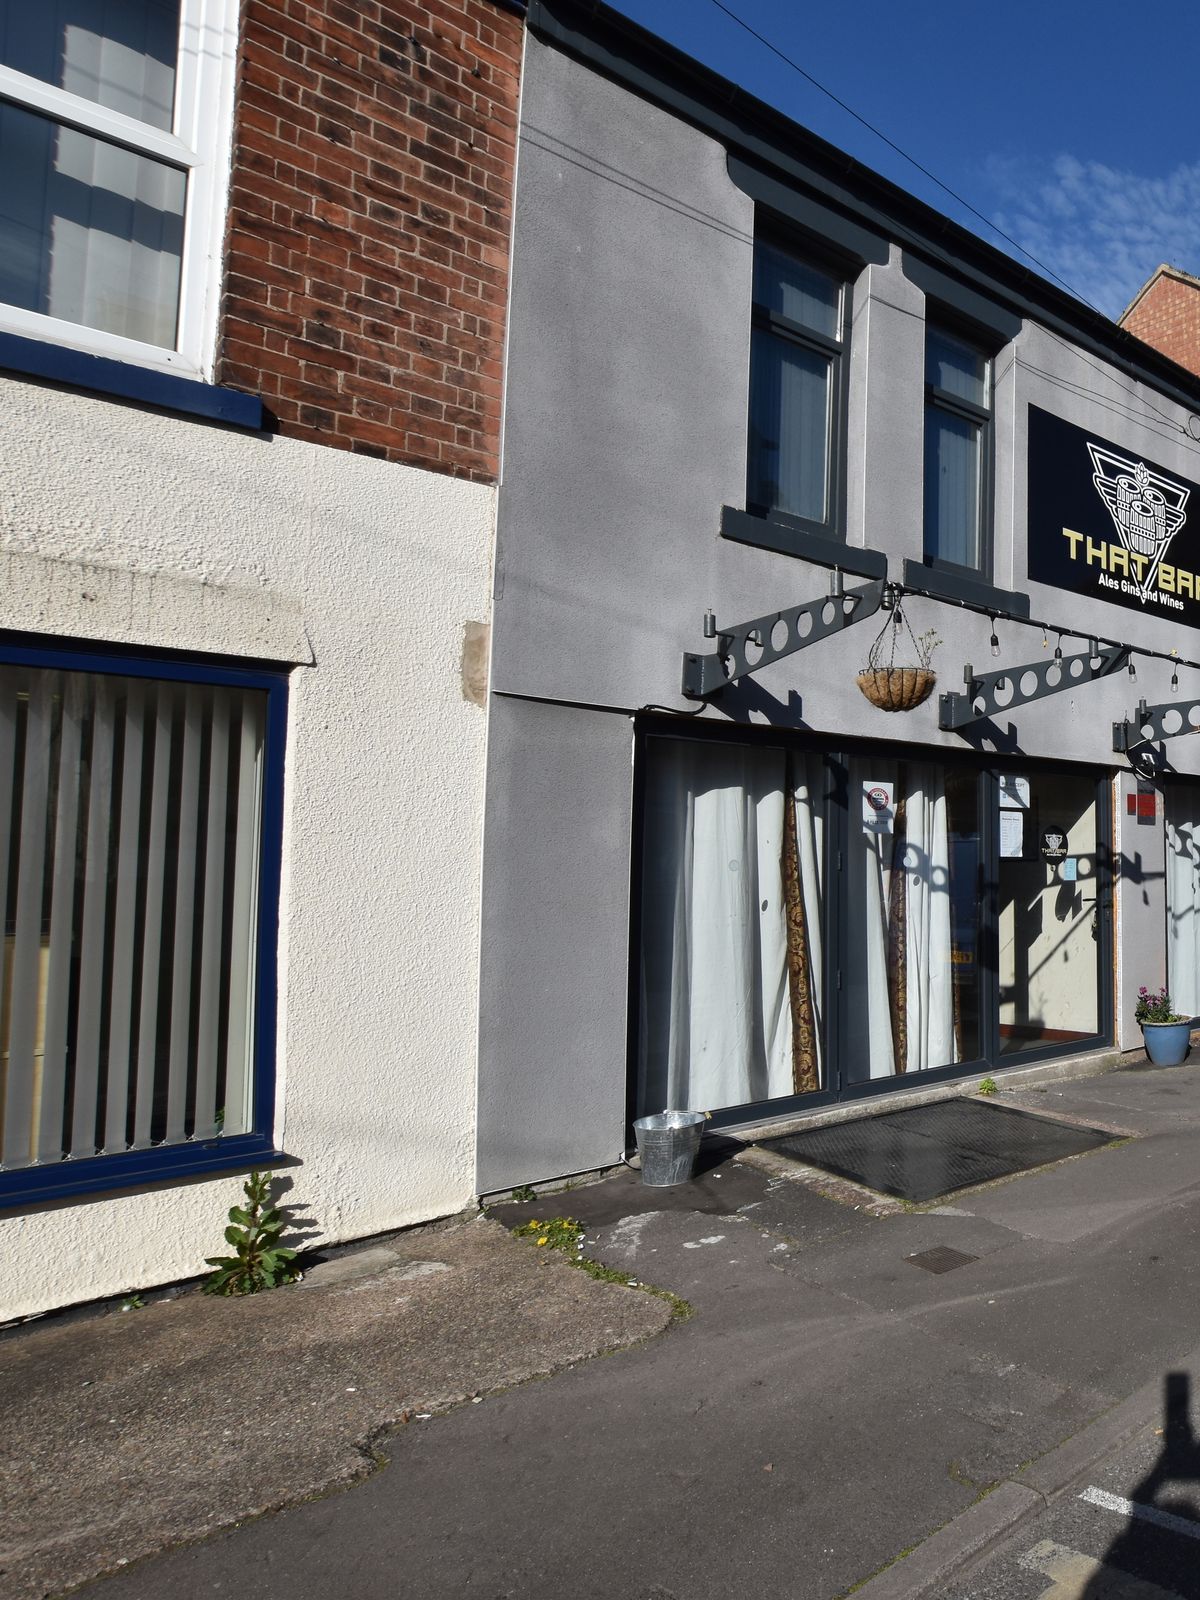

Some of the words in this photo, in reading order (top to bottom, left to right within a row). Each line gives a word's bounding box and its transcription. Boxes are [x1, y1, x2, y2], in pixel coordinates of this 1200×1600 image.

[1062, 527, 1149, 582] THAT
[1098, 572, 1120, 590] Ales
[1121, 579, 1141, 597] Gins
[1142, 588, 1158, 603] and
[1159, 591, 1185, 611] Wines
